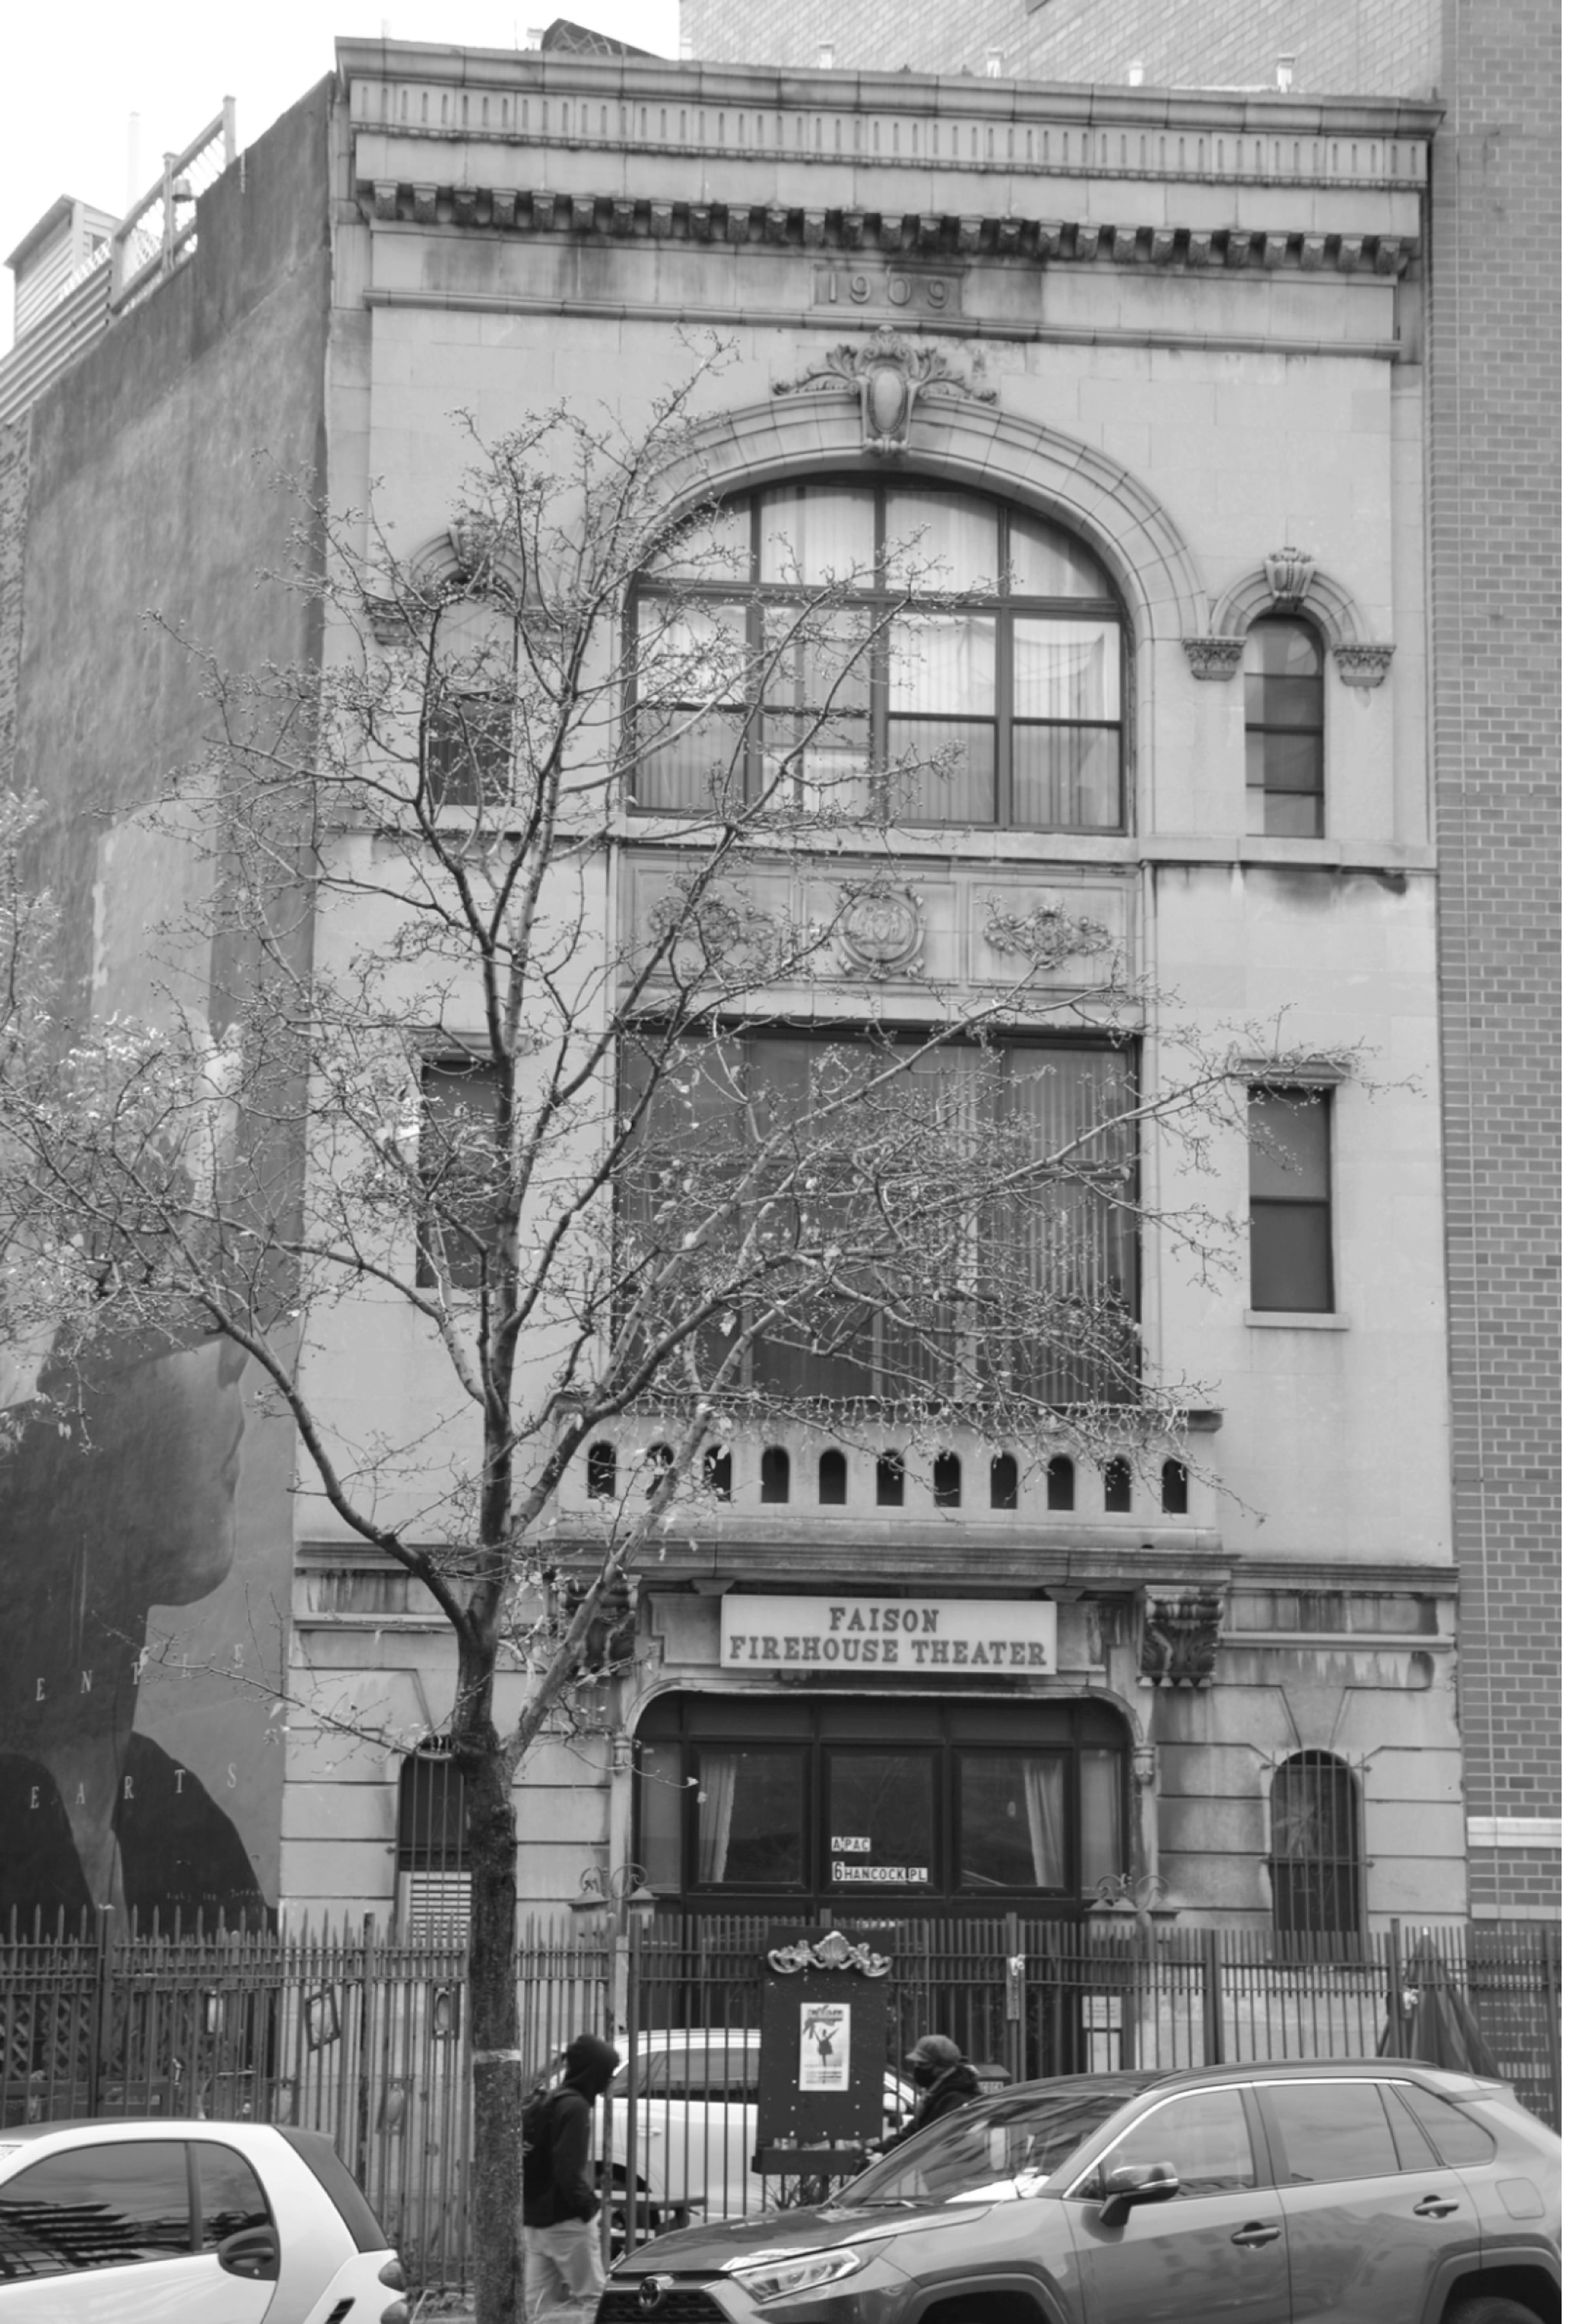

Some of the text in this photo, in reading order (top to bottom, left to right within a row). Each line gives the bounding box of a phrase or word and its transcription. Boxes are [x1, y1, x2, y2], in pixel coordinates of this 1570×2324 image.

[828, 273, 948, 310] 1909
[829, 1607, 940, 1633] FAISON
[730, 1636, 1047, 1666] FIREHOUSE THEATER
[833, 1863, 927, 1881] 6 HANCOCK PL
